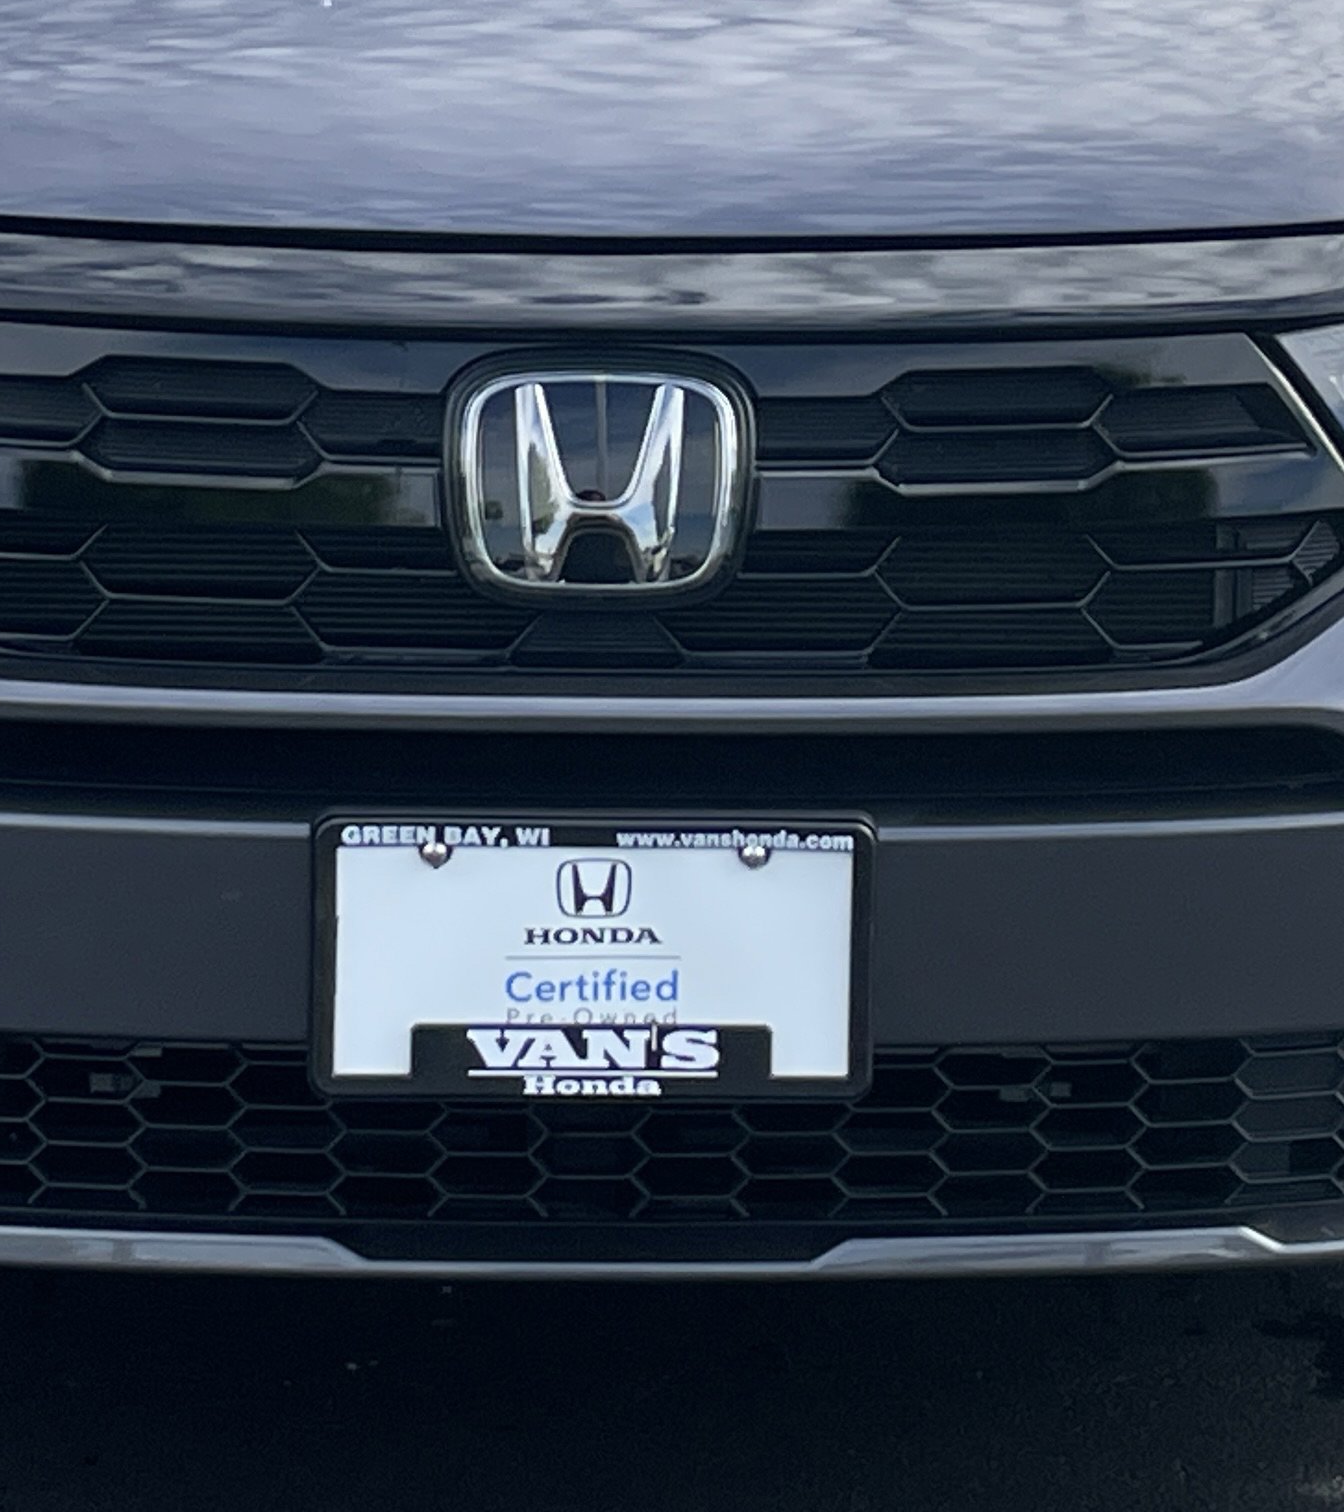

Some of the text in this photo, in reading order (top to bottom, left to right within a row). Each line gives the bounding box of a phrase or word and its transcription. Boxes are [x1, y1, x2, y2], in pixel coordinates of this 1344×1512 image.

[340, 824, 551, 849] GREEN BAY, WI
[616, 829, 854, 851] www.vanshonda.com
[524, 927, 662, 946] HONDA
[506, 968, 679, 1003] Certified
[506, 1007, 678, 1026] Pre-Owned
[466, 1026, 720, 1070] VAN'S
[522, 1074, 662, 1096] Honda
